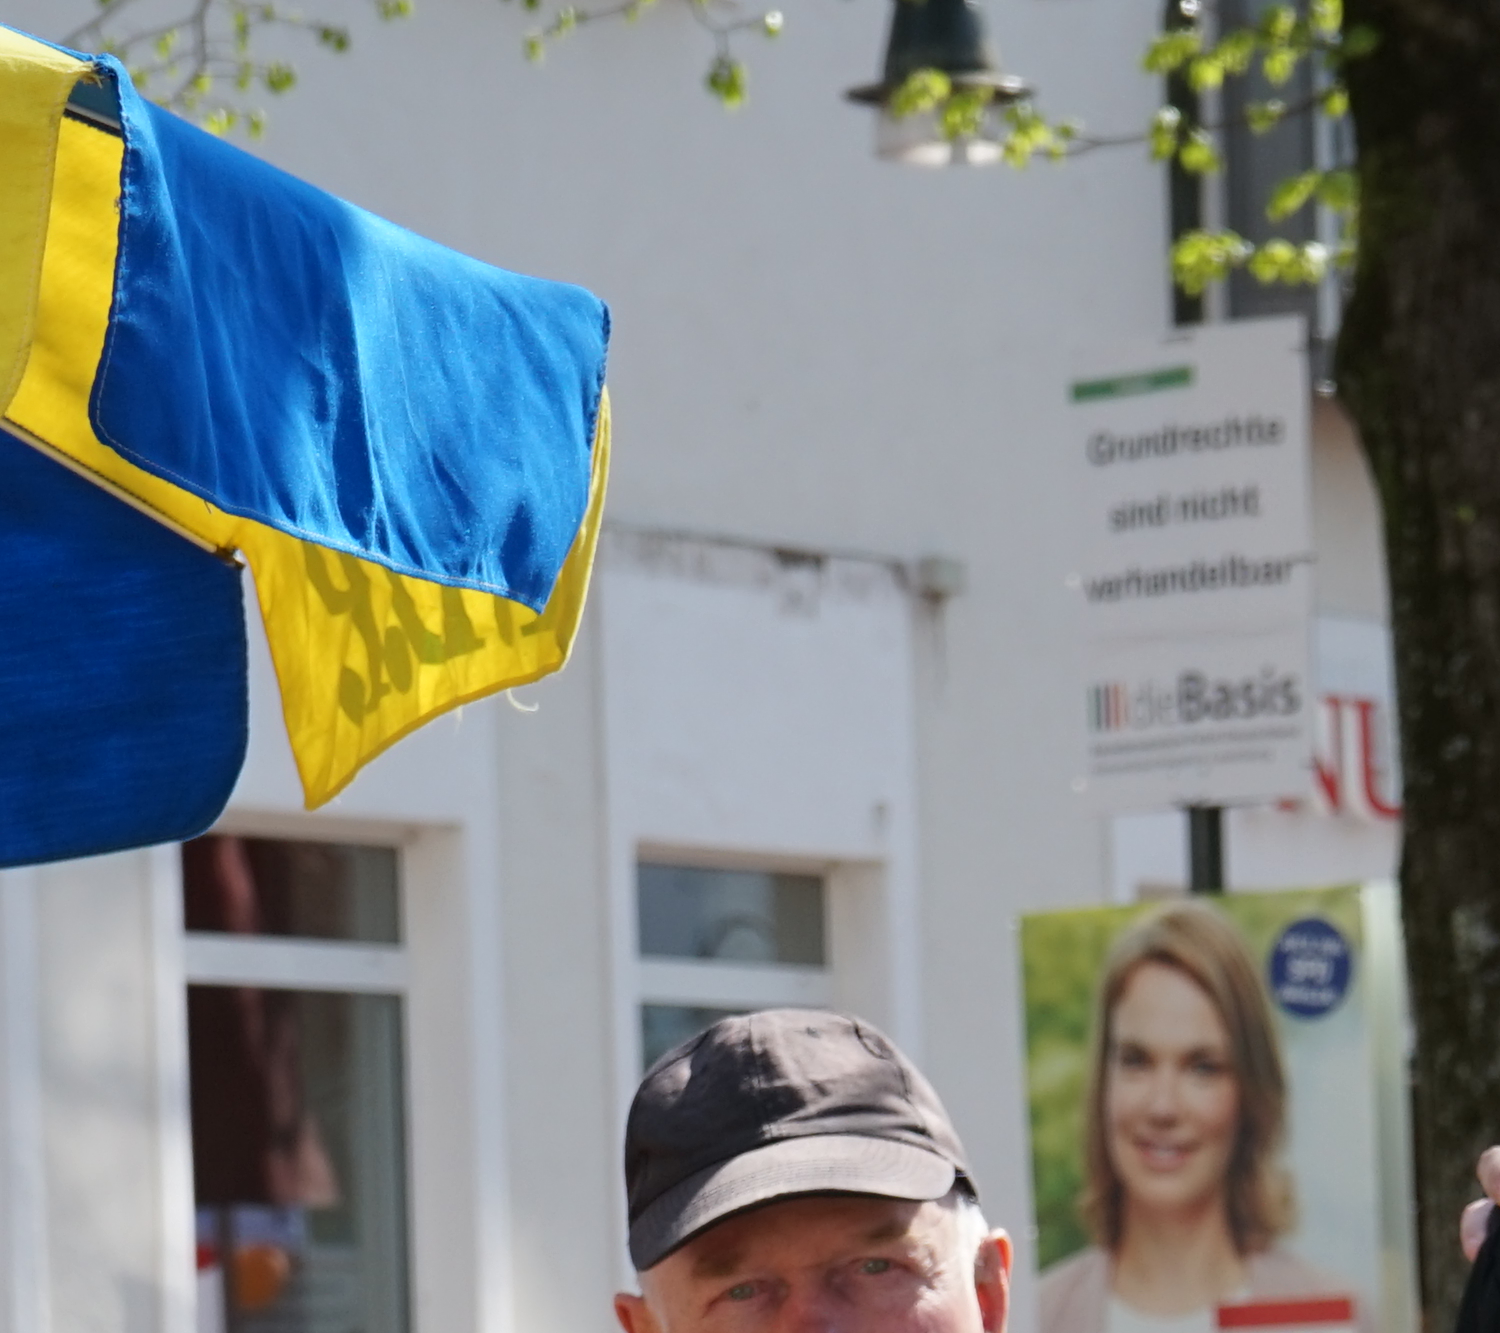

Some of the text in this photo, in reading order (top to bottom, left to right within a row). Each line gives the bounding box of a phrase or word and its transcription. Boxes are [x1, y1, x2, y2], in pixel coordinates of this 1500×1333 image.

[1088, 414, 1285, 466] Grundrechte
[1108, 486, 1261, 534] sind nicht
[1085, 555, 1294, 603] verhandelbar
